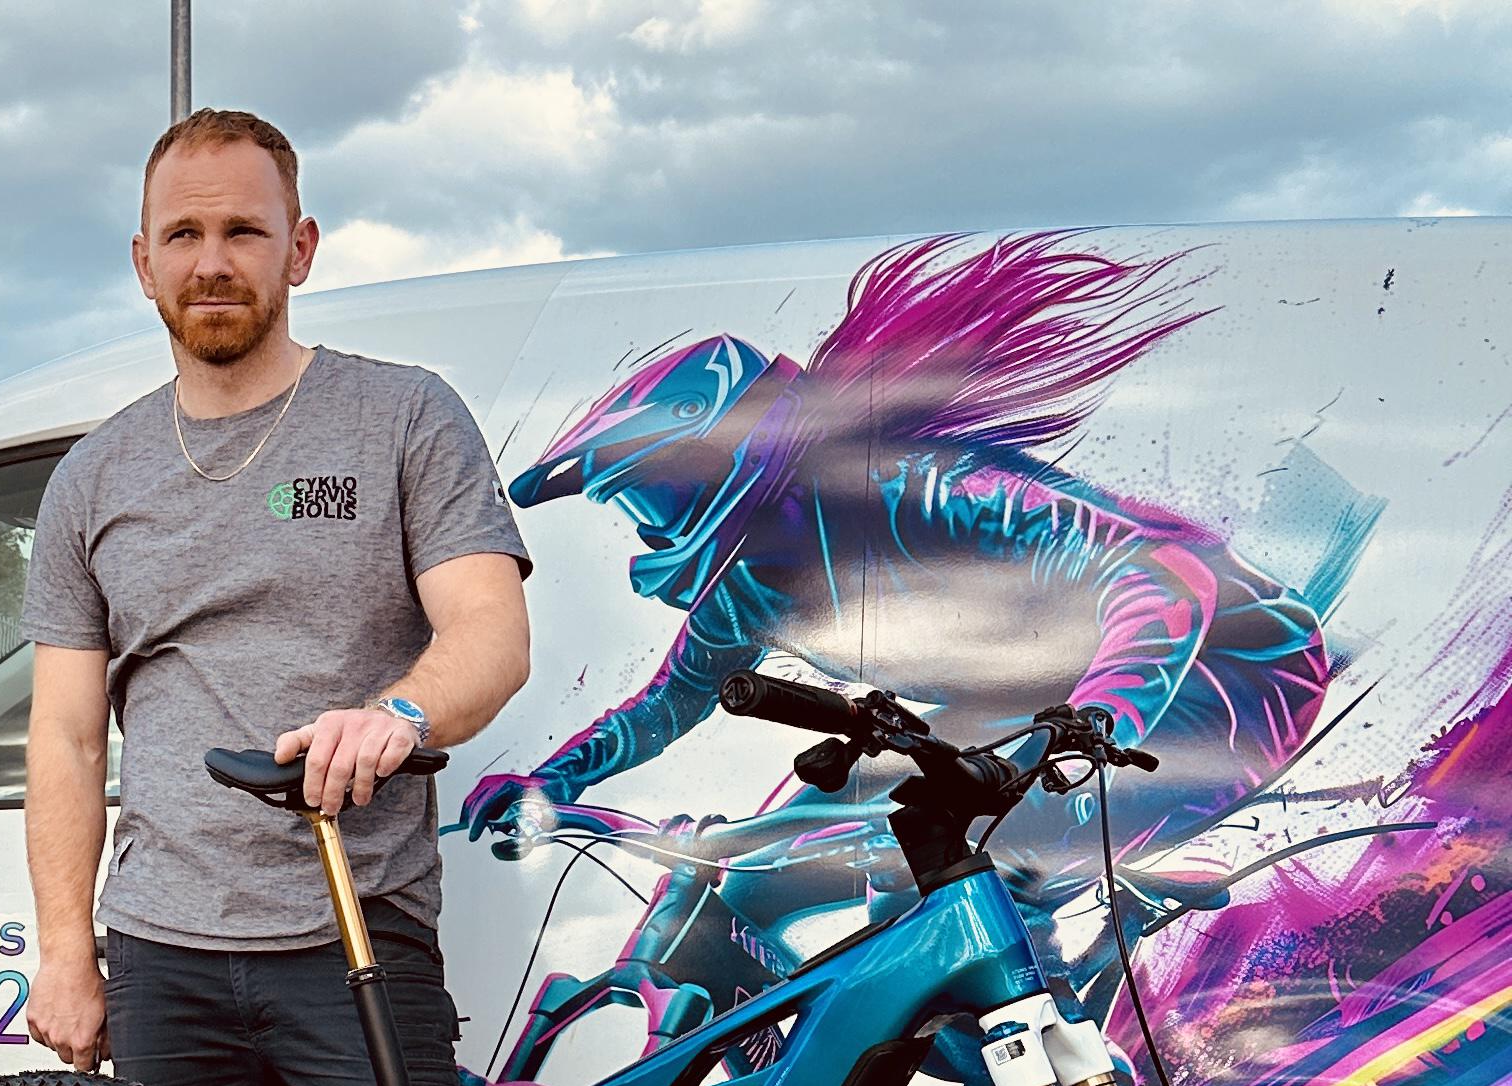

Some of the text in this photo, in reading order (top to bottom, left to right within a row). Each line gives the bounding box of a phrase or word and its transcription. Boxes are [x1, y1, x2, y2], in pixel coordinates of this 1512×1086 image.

[292, 476, 357, 492] CYKLO
[293, 486, 357, 505] SERVIS
[292, 501, 357, 520] BOLIS
